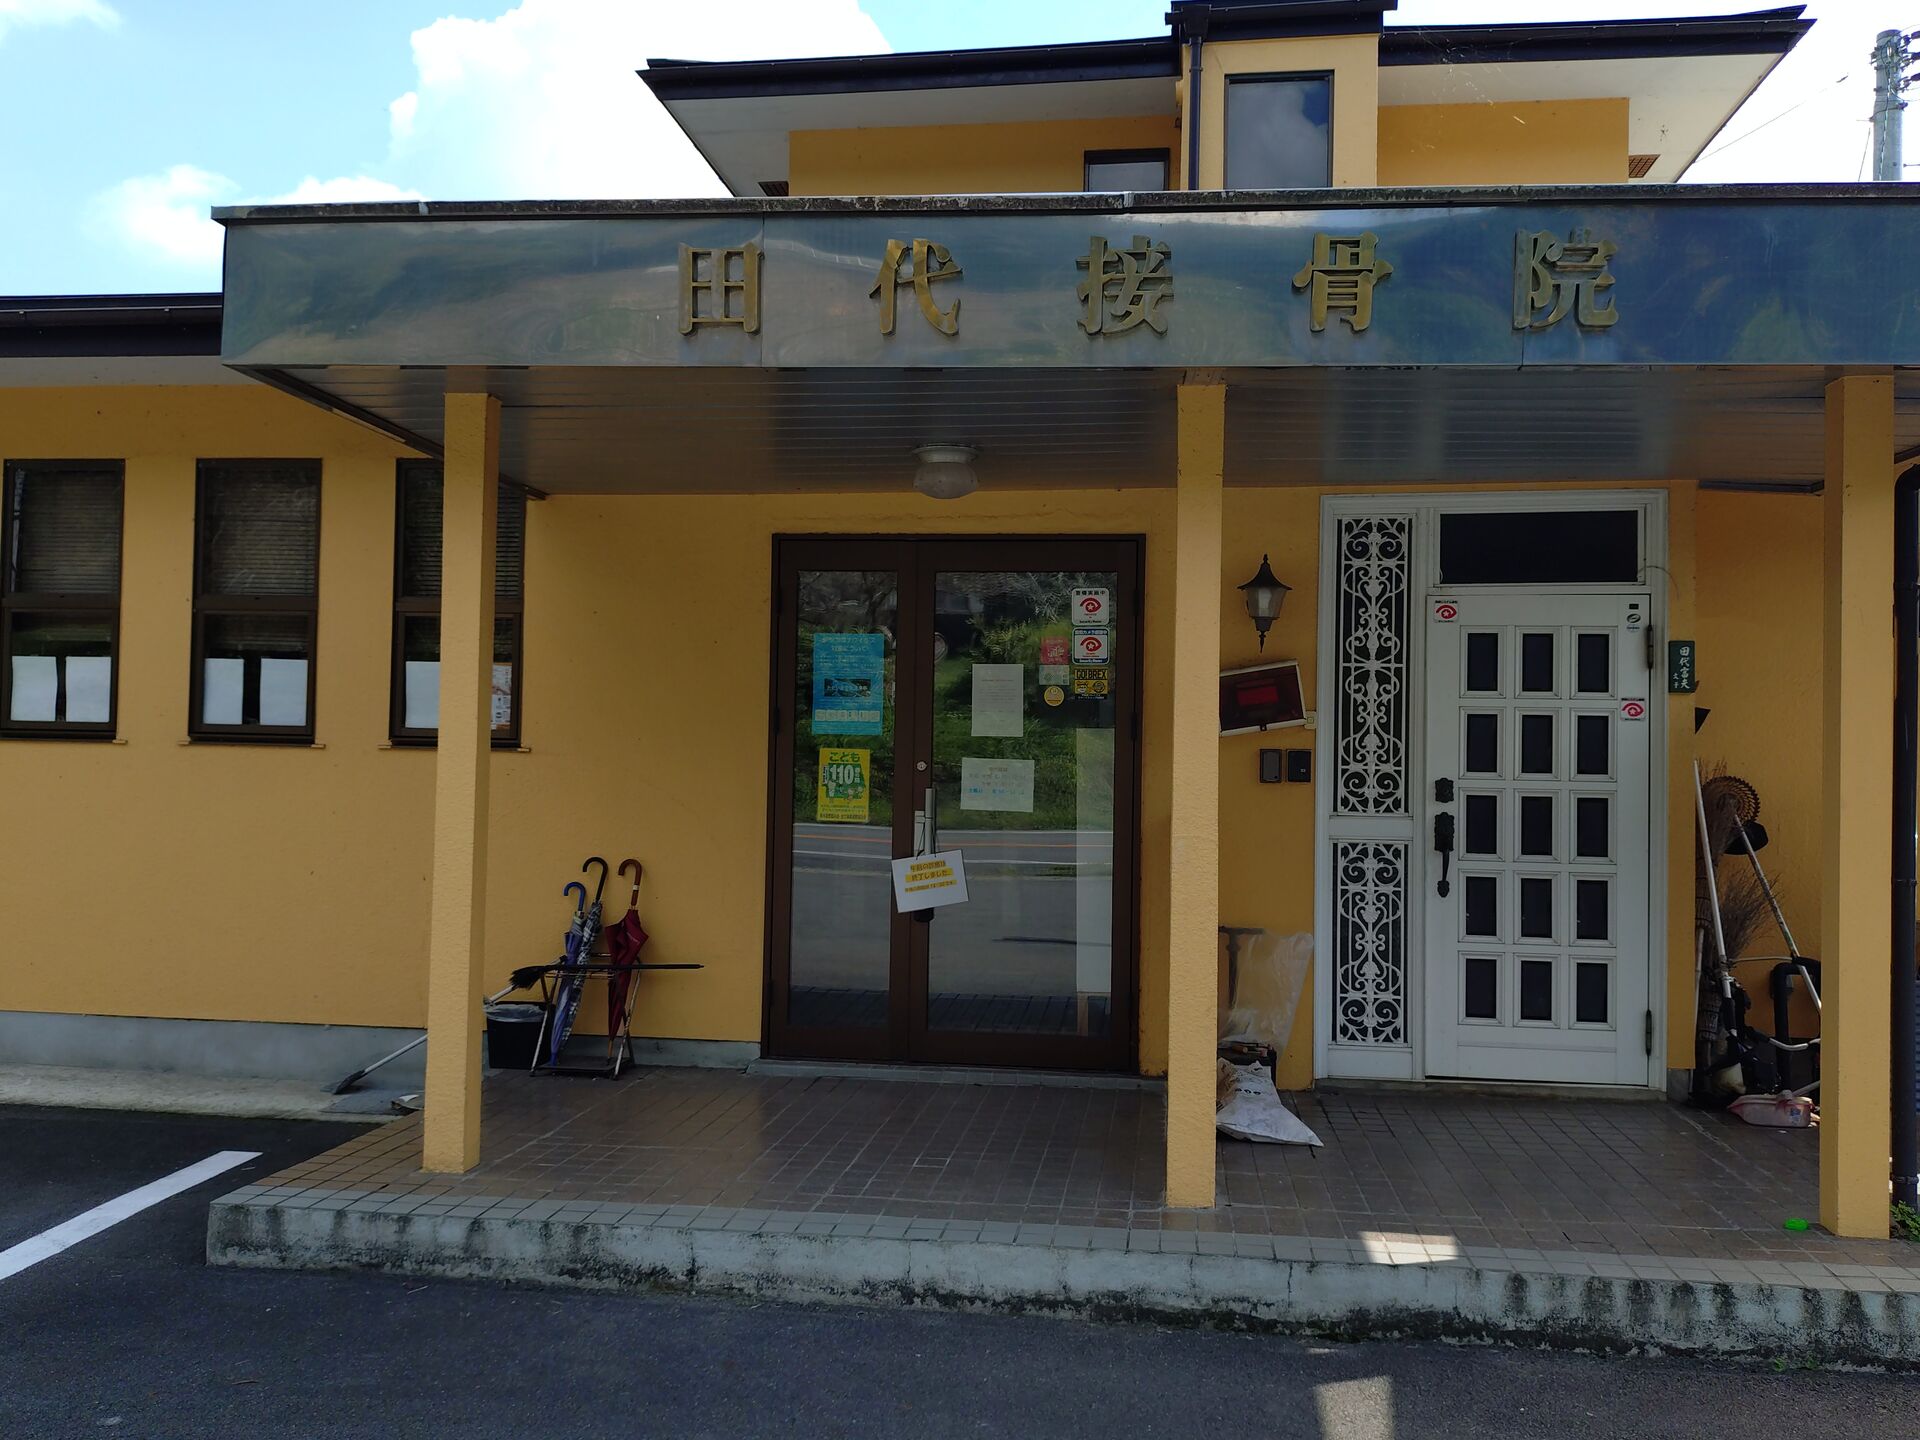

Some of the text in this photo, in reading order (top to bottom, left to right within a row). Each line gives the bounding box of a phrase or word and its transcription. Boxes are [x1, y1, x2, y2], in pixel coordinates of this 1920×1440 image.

[679, 229, 1621, 335] 田代接骨院
[1678, 646, 1691, 689] 田代富夫
[829, 752, 860, 763] こども
[829, 764, 854, 785] 110
